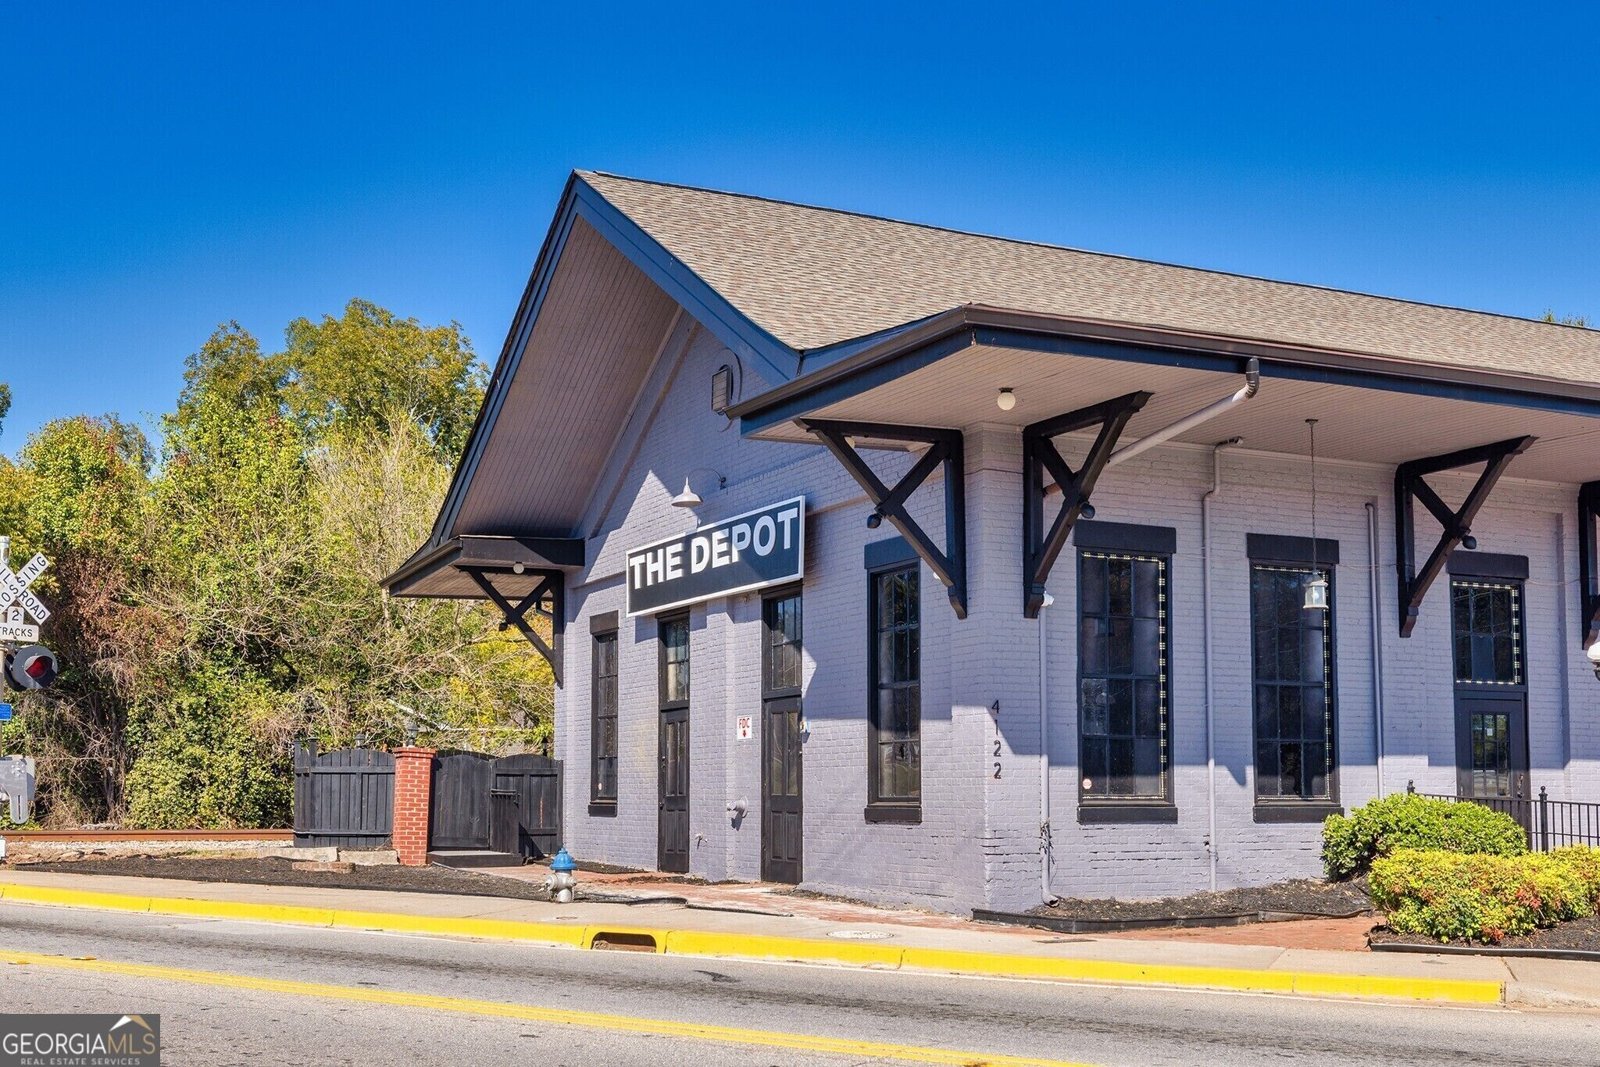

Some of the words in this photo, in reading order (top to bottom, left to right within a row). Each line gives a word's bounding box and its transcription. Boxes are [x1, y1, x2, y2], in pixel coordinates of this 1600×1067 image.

[629, 542, 684, 590] THE
[691, 507, 798, 574] DEPOT
[12, 610, 19, 621] 2
[18, 590, 46, 620] ROAD
[739, 717, 750, 729] FDC
